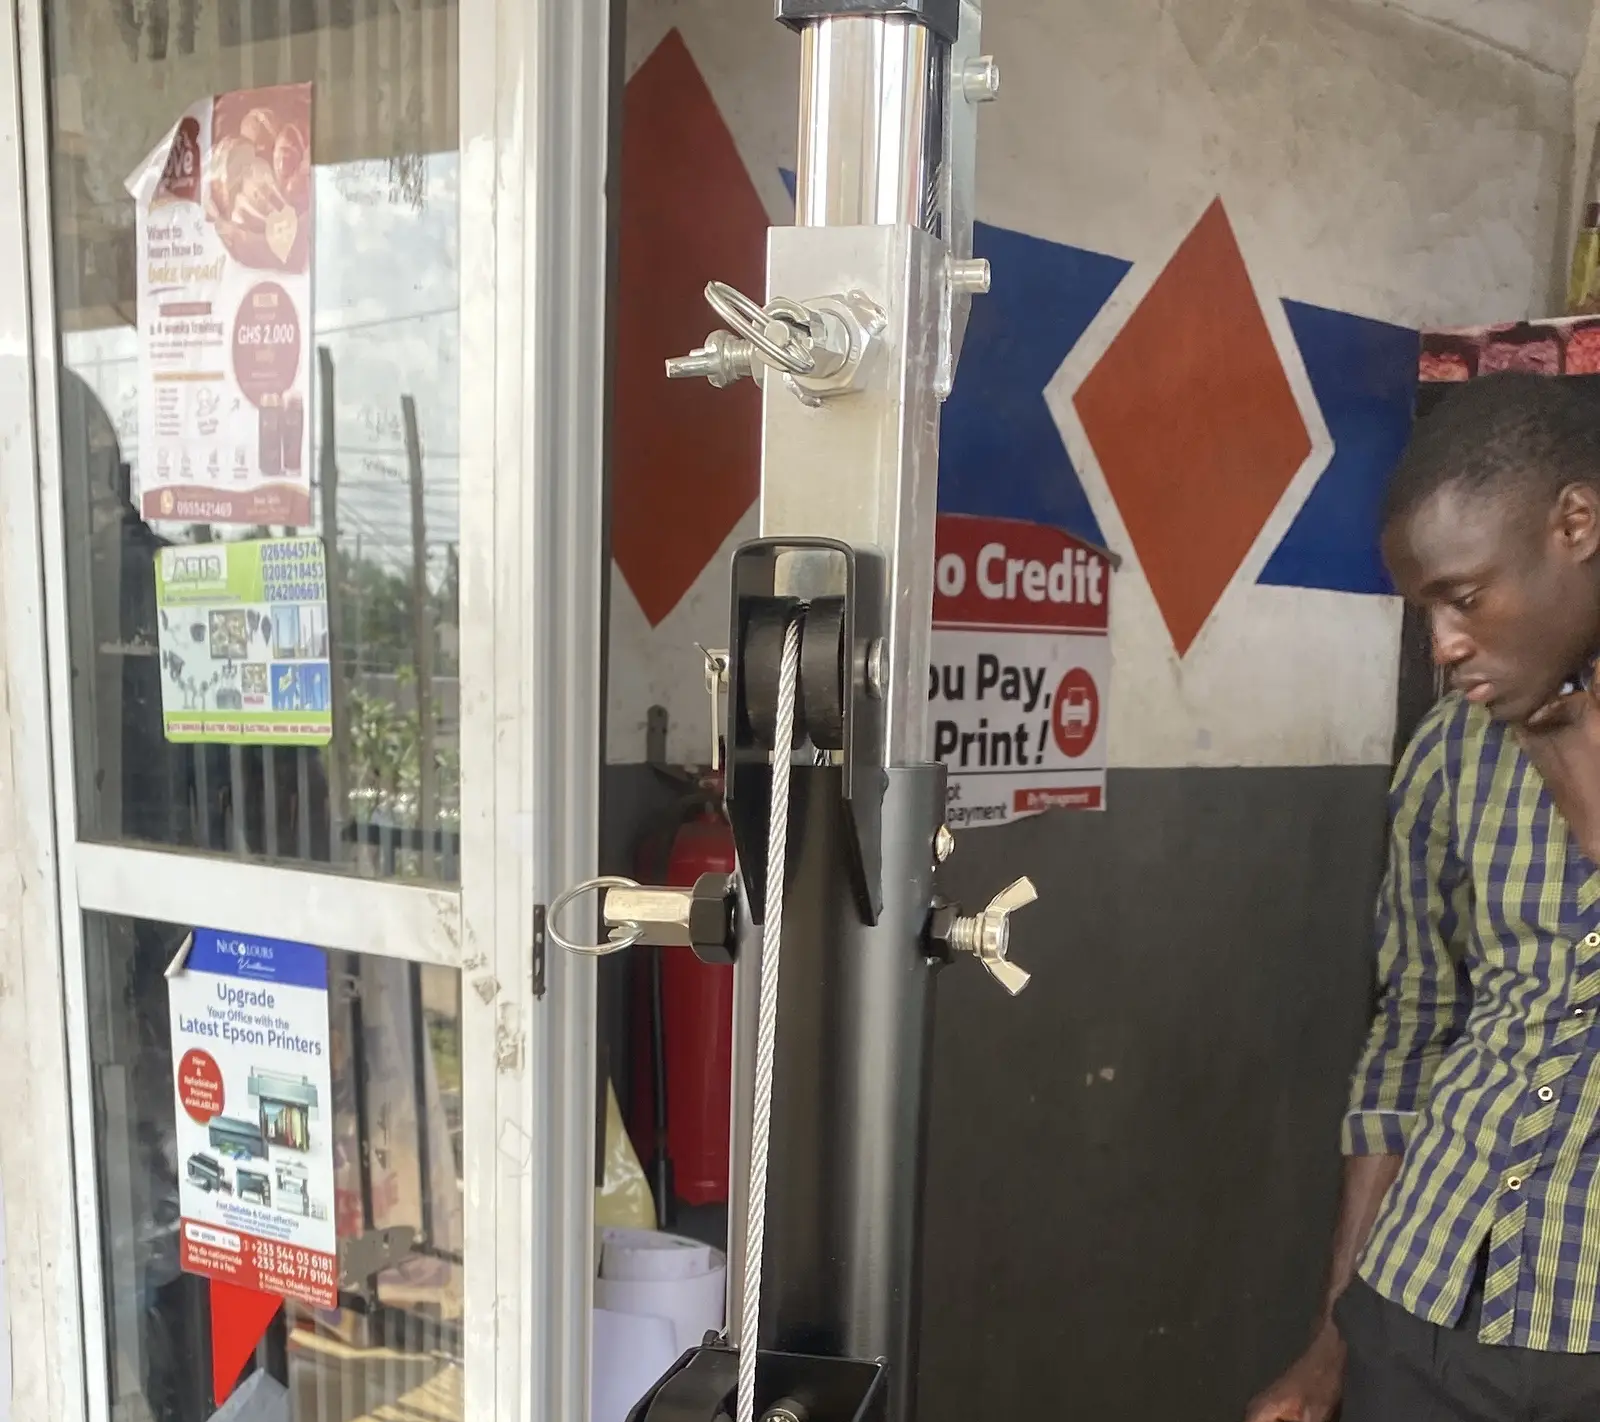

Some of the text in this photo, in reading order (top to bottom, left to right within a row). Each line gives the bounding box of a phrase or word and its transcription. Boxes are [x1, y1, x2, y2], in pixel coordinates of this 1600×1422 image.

[147, 223, 182, 241] Want to
[147, 241, 204, 259] learn how to
[238, 324, 261, 344] GHS
[934, 541, 1103, 606] o Credit
[927, 653, 1051, 714] ou Pay,
[217, 982, 275, 1009] Upgrade
[207, 1005, 290, 1031] Your Office with the
[179, 1014, 322, 1056] Latest Epson Printers
[251, 1240, 274, 1257] +233
[276, 1245, 294, 1262] 544
[296, 1250, 309, 1266] 03
[311, 1255, 332, 1273] 6181
[251, 1255, 333, 1287] +233 264 77 9194
